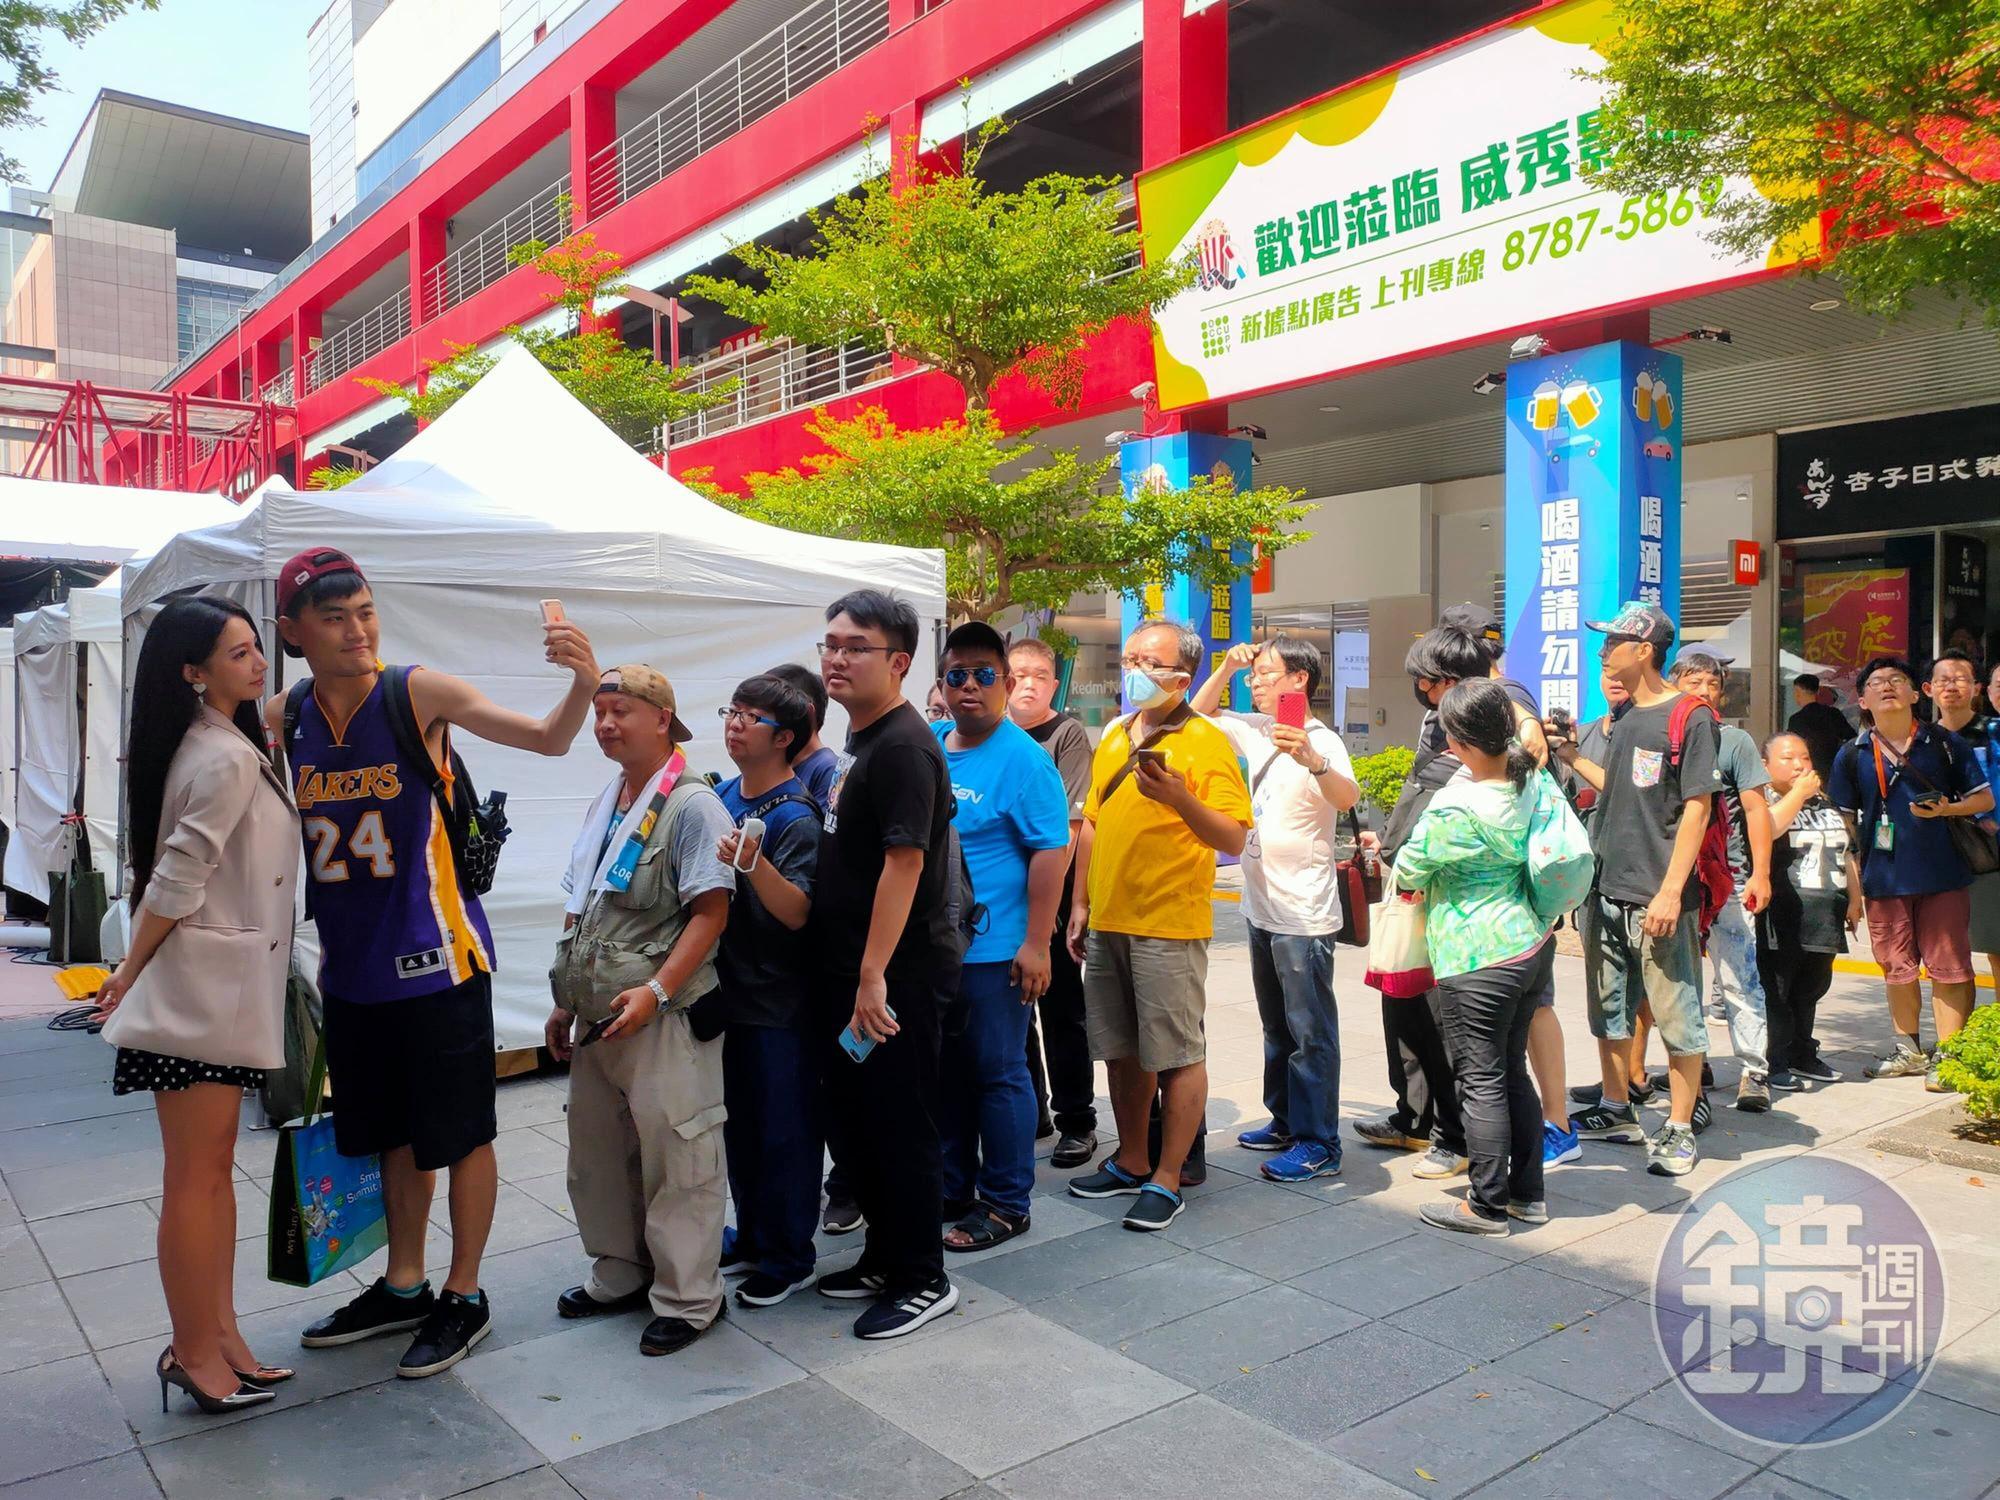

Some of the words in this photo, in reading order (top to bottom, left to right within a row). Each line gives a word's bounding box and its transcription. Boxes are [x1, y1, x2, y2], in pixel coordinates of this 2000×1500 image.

[1254, 167, 1440, 277] 歡迎蒞臨
[1460, 107, 1698, 214] 威秀影
[1240, 285, 1362, 344] 新據點廣告
[1370, 248, 1486, 310] 上刊專線
[1502, 174, 1724, 272] 8787-5869
[1072, 680, 1106, 695] Redmi
[297, 763, 402, 809] LAKERS
[304, 810, 396, 883] 24
[359, 1171, 381, 1184] Sma
